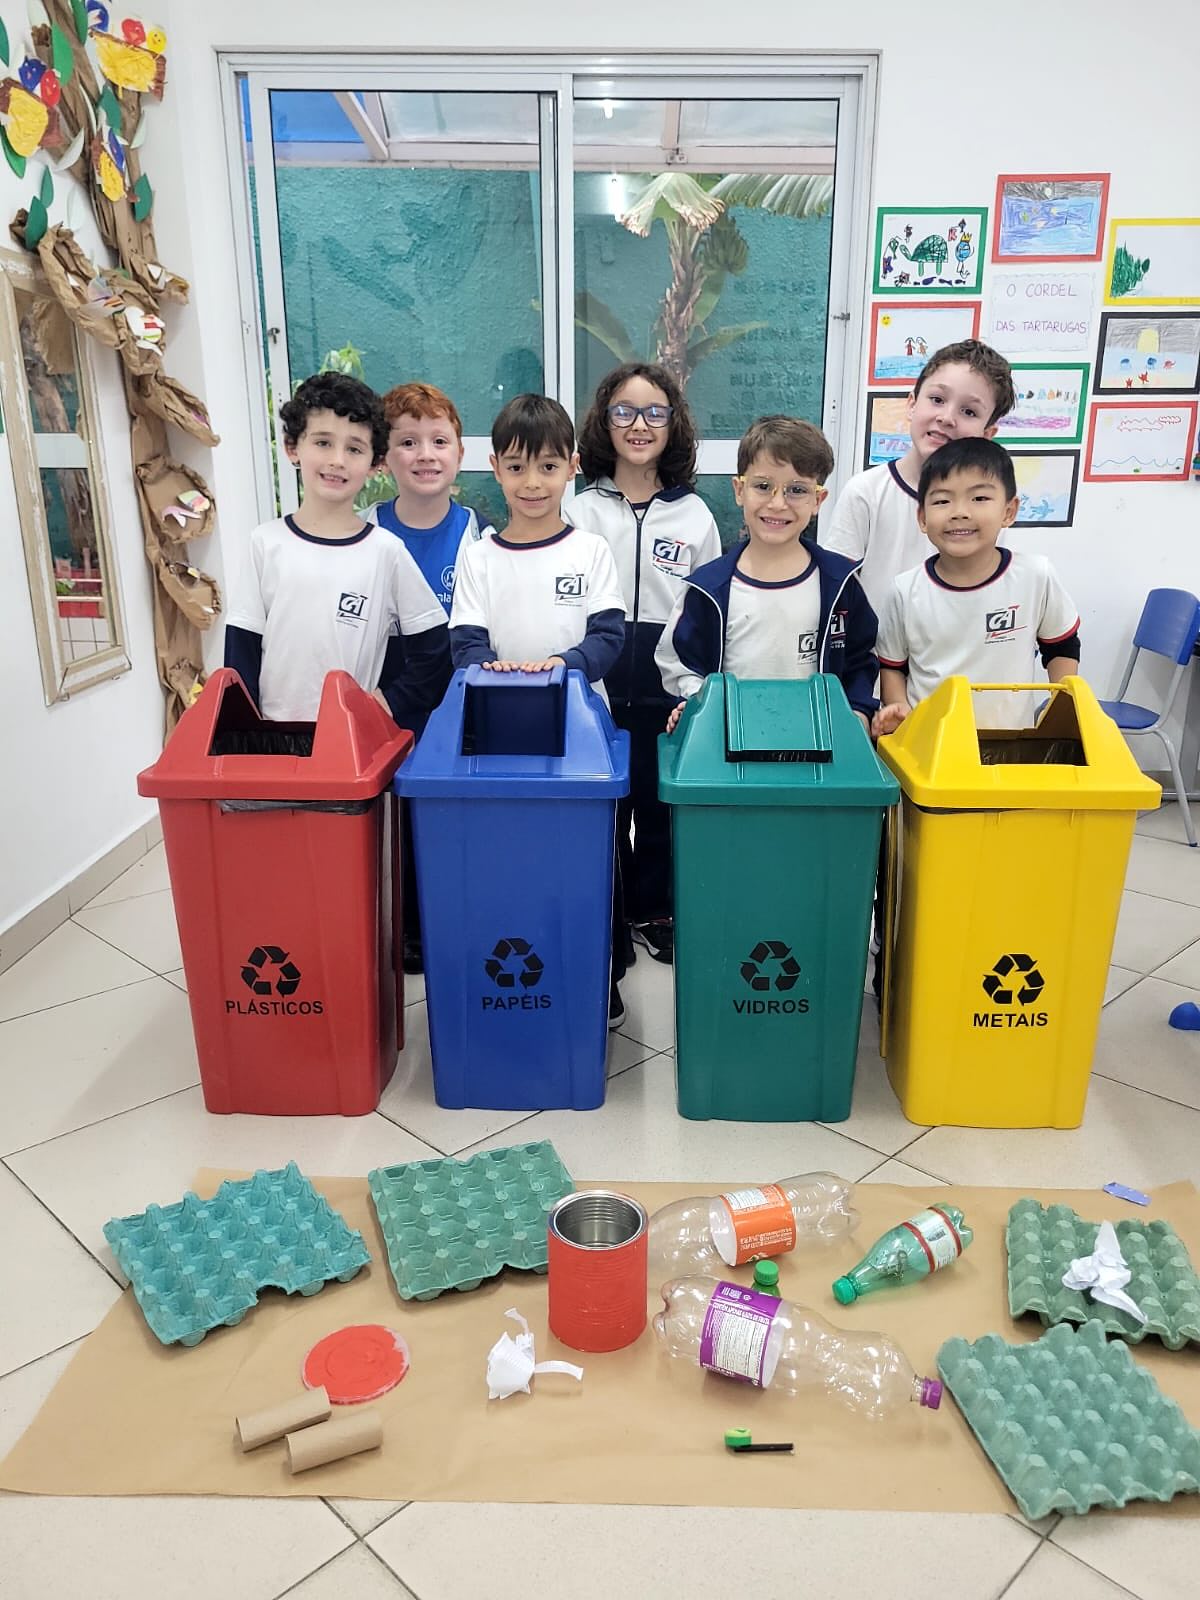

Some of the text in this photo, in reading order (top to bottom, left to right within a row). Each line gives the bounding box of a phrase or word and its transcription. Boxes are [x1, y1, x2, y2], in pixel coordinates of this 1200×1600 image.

[1006, 283, 1077, 297] O CORDEL
[995, 320, 1087, 334] DAS TARTARUGAS
[225, 999, 324, 1016] PLÁSTICOS
[482, 993, 552, 1010] PAPÉIS
[733, 998, 809, 1015] VIDROS
[973, 1012, 1049, 1028] METAIS
